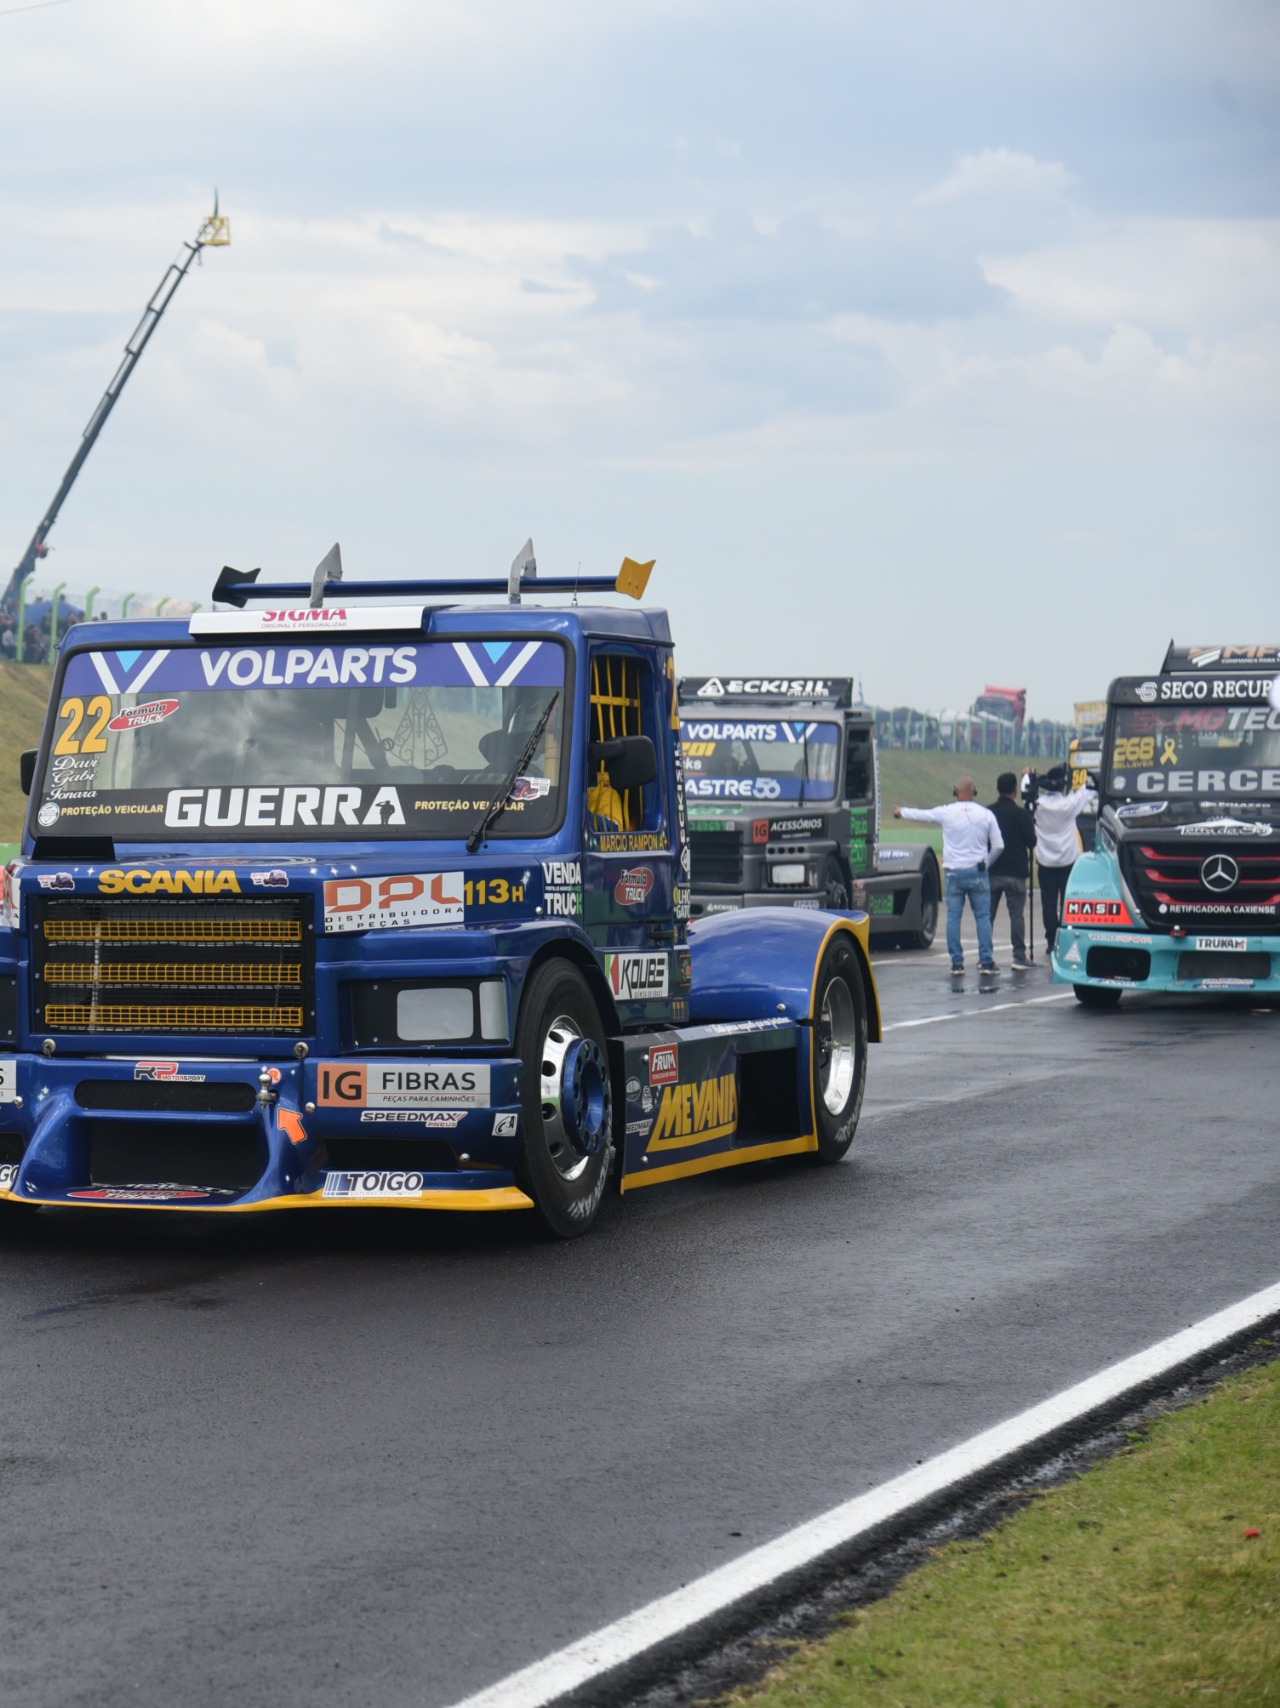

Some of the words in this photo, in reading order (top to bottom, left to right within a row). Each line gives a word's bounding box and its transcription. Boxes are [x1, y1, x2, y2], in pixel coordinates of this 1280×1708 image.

[262, 608, 347, 621] SIGMA
[200, 646, 418, 686] VOLPARTS
[723, 679, 830, 694] ECKISIL
[1161, 681, 1207, 699] SECO
[53, 696, 112, 755] 22
[128, 713, 163, 726] TRUCK
[687, 724, 777, 740] VOLPARTS
[1113, 737, 1155, 762] 268
[52, 756, 99, 771] Davi
[51, 771, 97, 787] Gabi
[1137, 770, 1280, 793] CERCE
[61, 804, 112, 816] PROTEÇÃO
[114, 804, 164, 814] VEICULAR
[164, 786, 406, 827] GUERRA
[415, 801, 470, 811] PROTEÇÃO
[755, 825, 767, 837] IG
[770, 819, 822, 831] ACESSÓRIOS
[600, 834, 627, 852] MARCIO
[629, 834, 656, 851] RAMPON
[98, 870, 241, 893] SCANIA
[542, 863, 582, 884] VENDA
[325, 875, 463, 913] DPL
[625, 885, 645, 902] TRUCK
[544, 893, 583, 915] TRUCK
[1069, 903, 1118, 915] MASI
[1170, 904, 1231, 913] RETIFICADORA
[1233, 905, 1275, 913] CAXIENSE
[325, 907, 464, 923] DISTRIBUIDORA
[357, 919, 411, 928] PEÇAS
[621, 958, 666, 998] KOUBE
[651, 1051, 676, 1072] FRUM
[134, 1063, 178, 1080] RP
[323, 1071, 362, 1099] IG
[382, 1072, 476, 1090] FIBRAS
[430, 1095, 476, 1103] CAMINHÕES
[363, 1112, 457, 1121] SPEEDMAX
[347, 1173, 423, 1191] TOIGO
